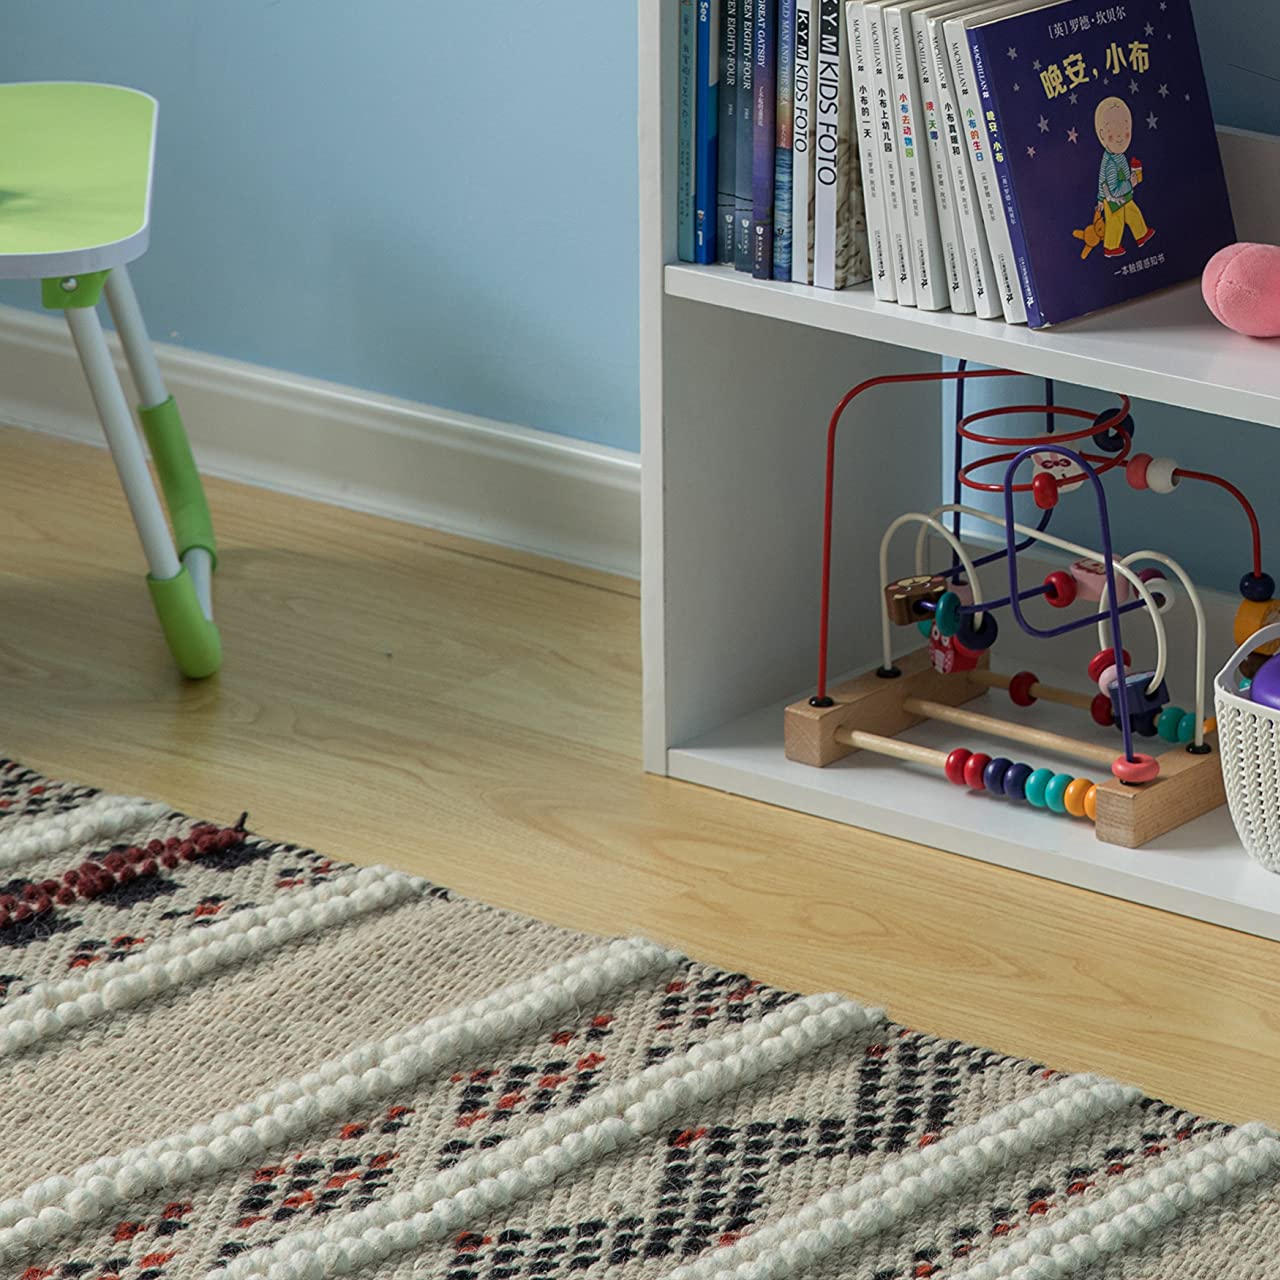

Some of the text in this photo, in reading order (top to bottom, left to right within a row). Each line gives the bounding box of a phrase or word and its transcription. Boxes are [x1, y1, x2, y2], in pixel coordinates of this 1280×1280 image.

[700, 1, 709, 22] Sea
[757, 30, 766, 68] GATSBY
[854, 19, 864, 64] MACMILLAN
[871, 22, 881, 67] MACMILLAN
[893, 26, 903, 72] MACMILLAN
[916, 30, 928, 76] MACMILLAN
[933, 36, 945, 82] MACMILLAN
[796, 64, 808, 102] KIDS
[819, 61, 839, 114] KIDS
[952, 42, 967, 88] MACMILLAN
[973, 45, 988, 91] MACMILLAN
[794, 106, 808, 153] FOTO
[859, 84, 872, 139] 小布的一天
[878, 88, 893, 152] 小布上幼儿园
[900, 93, 915, 158] 小布去动物园
[966, 108, 984, 161] 小布的生日
[818, 122, 838, 185] FOTO
